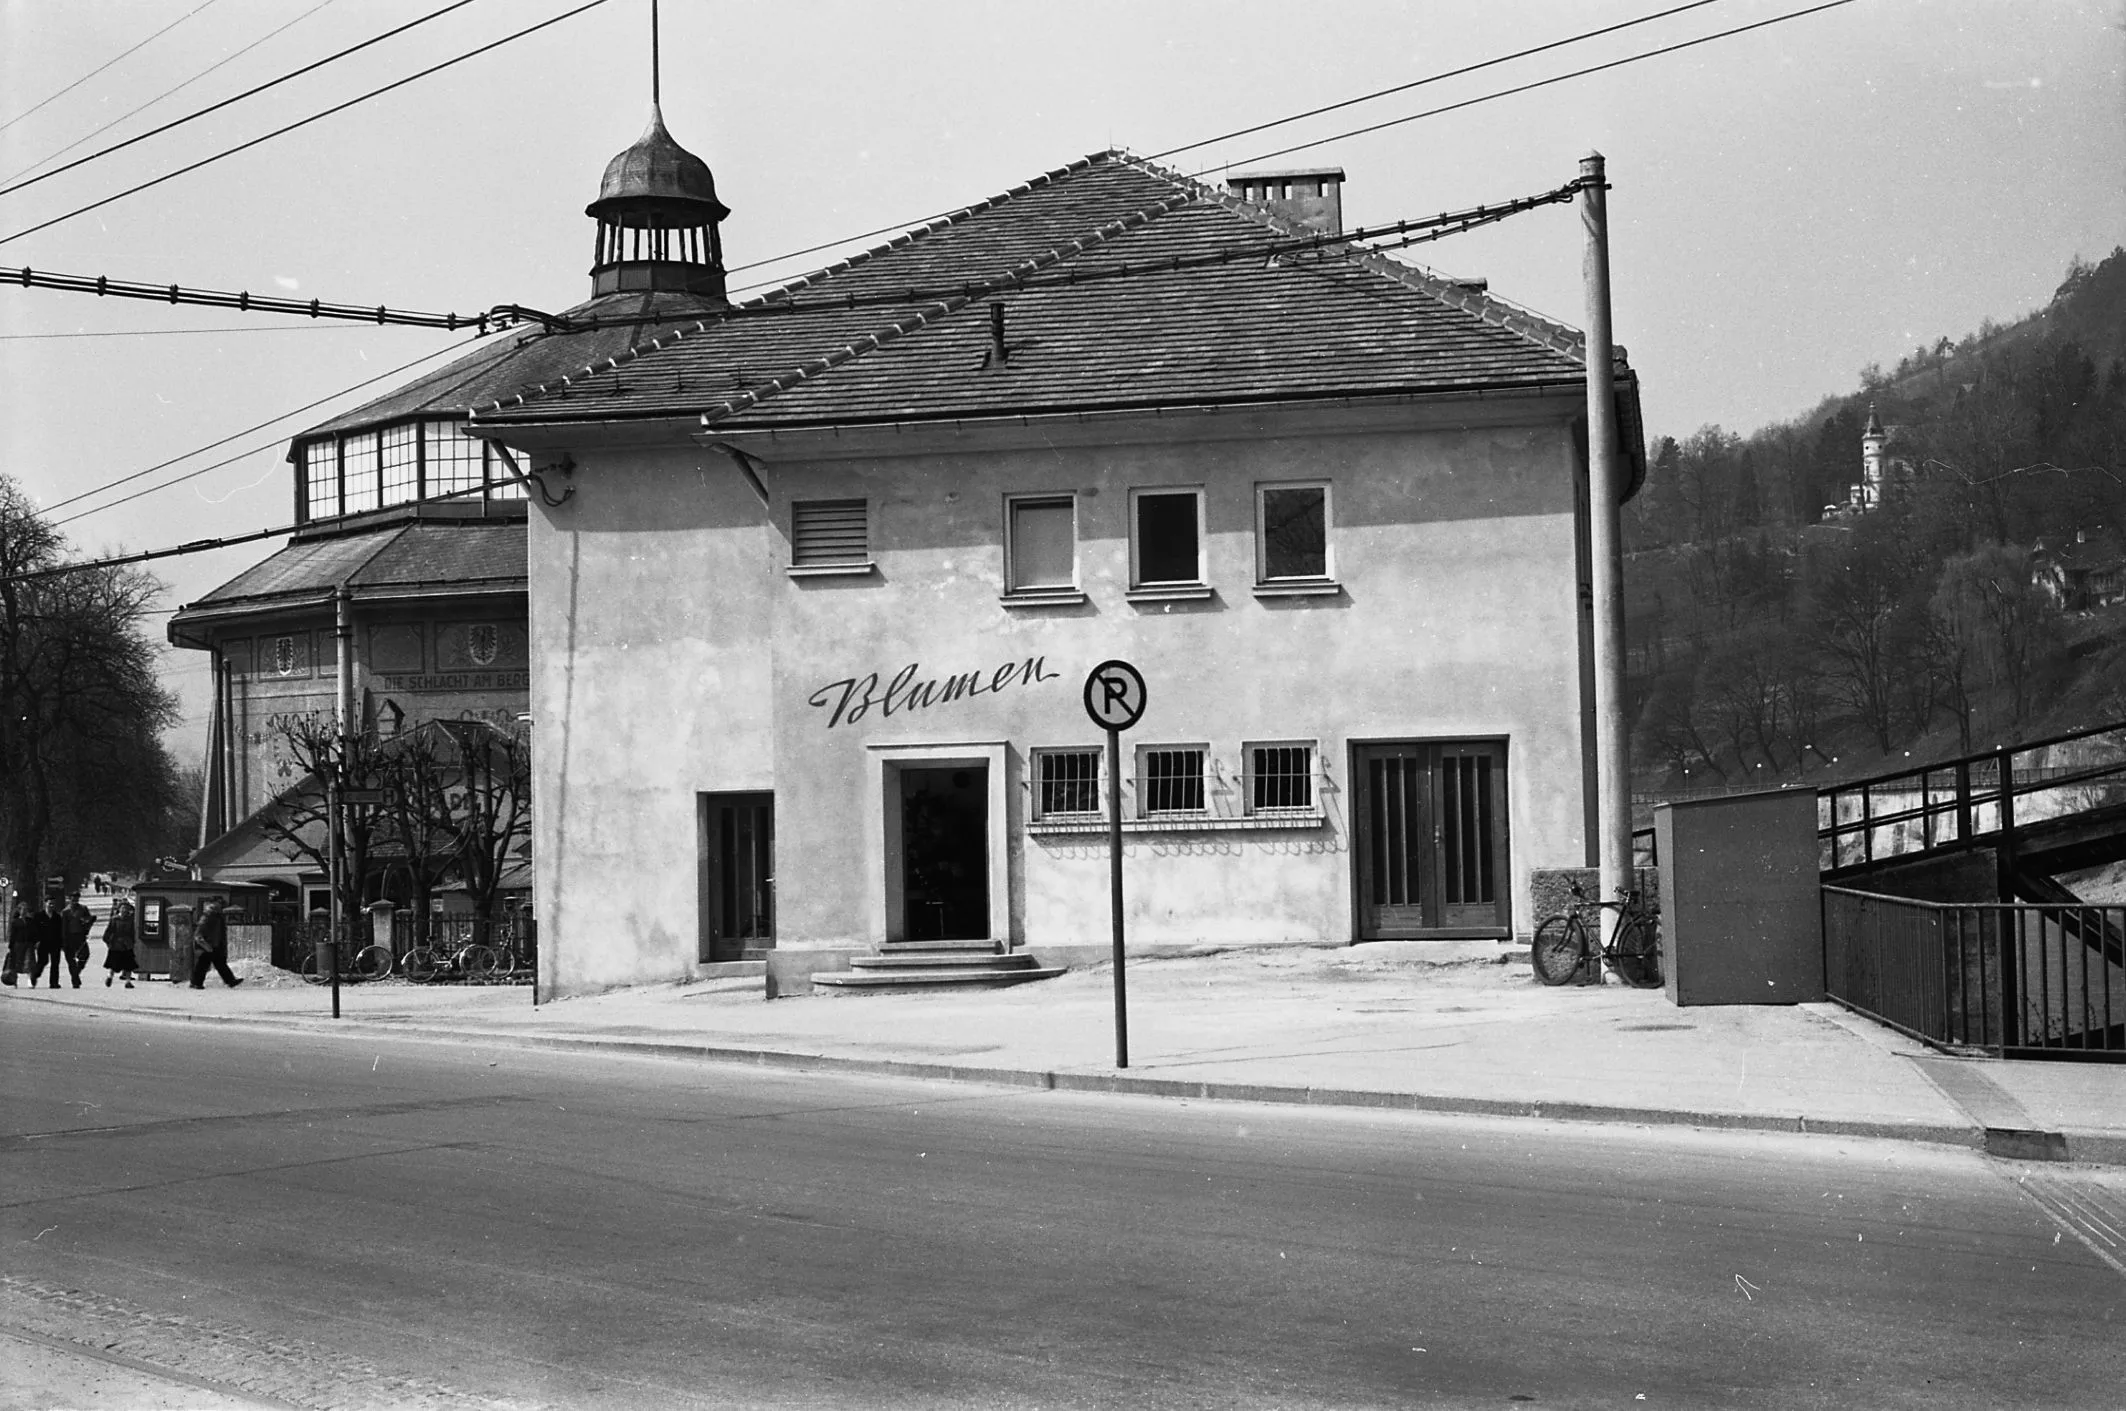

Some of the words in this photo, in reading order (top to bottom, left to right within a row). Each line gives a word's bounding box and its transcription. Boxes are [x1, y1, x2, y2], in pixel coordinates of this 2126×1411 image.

[385, 676, 403, 689] DIE
[409, 675, 468, 689] SCHLACHT
[474, 674, 491, 687] AM
[809, 656, 1060, 728] Blumen
[383, 790, 394, 802] H
